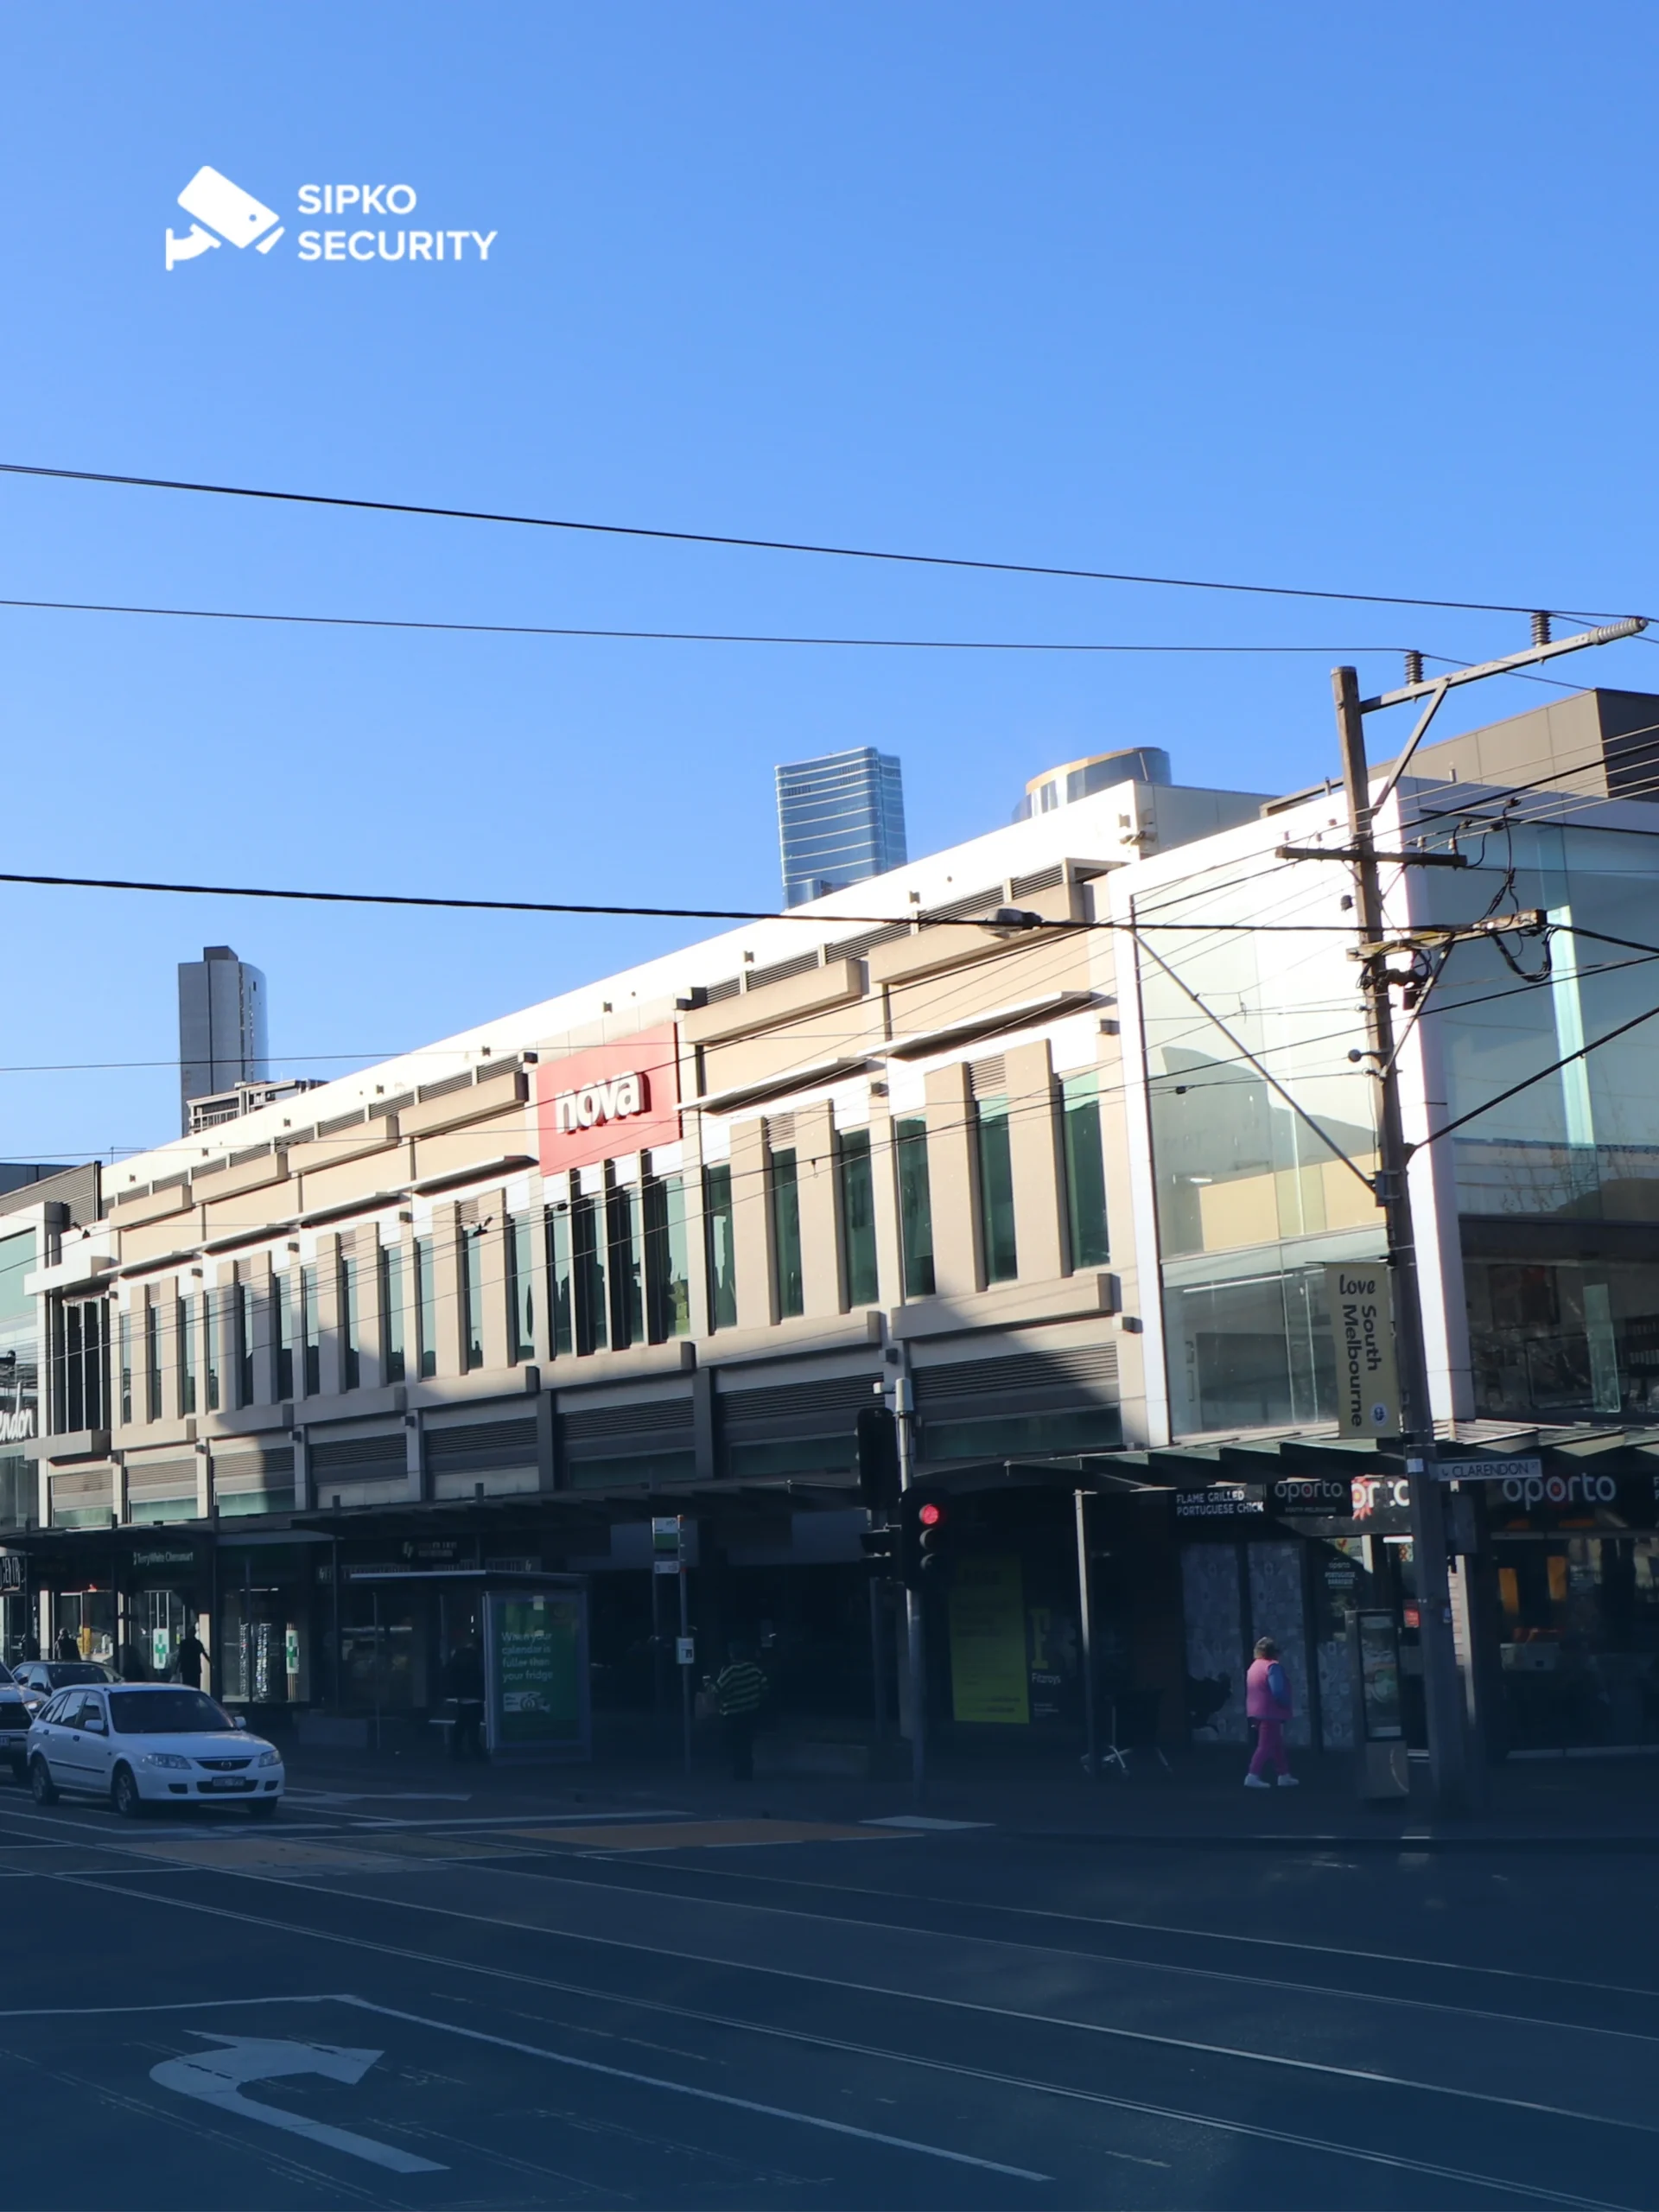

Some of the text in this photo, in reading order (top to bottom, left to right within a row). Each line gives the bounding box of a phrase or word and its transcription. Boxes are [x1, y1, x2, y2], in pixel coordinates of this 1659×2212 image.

[555, 1071, 642, 1135] nova
[1363, 1304, 1382, 1371] South
[1342, 1304, 1363, 1427] Melbourne
[1452, 1462, 1529, 1478] CLARENDON
[1176, 1490, 1244, 1503] FLAME GRILLED
[1274, 1479, 1343, 1503] oporto
[1503, 1472, 1616, 1511] oporto
[1177, 1503, 1234, 1516] PORTUGUESE
